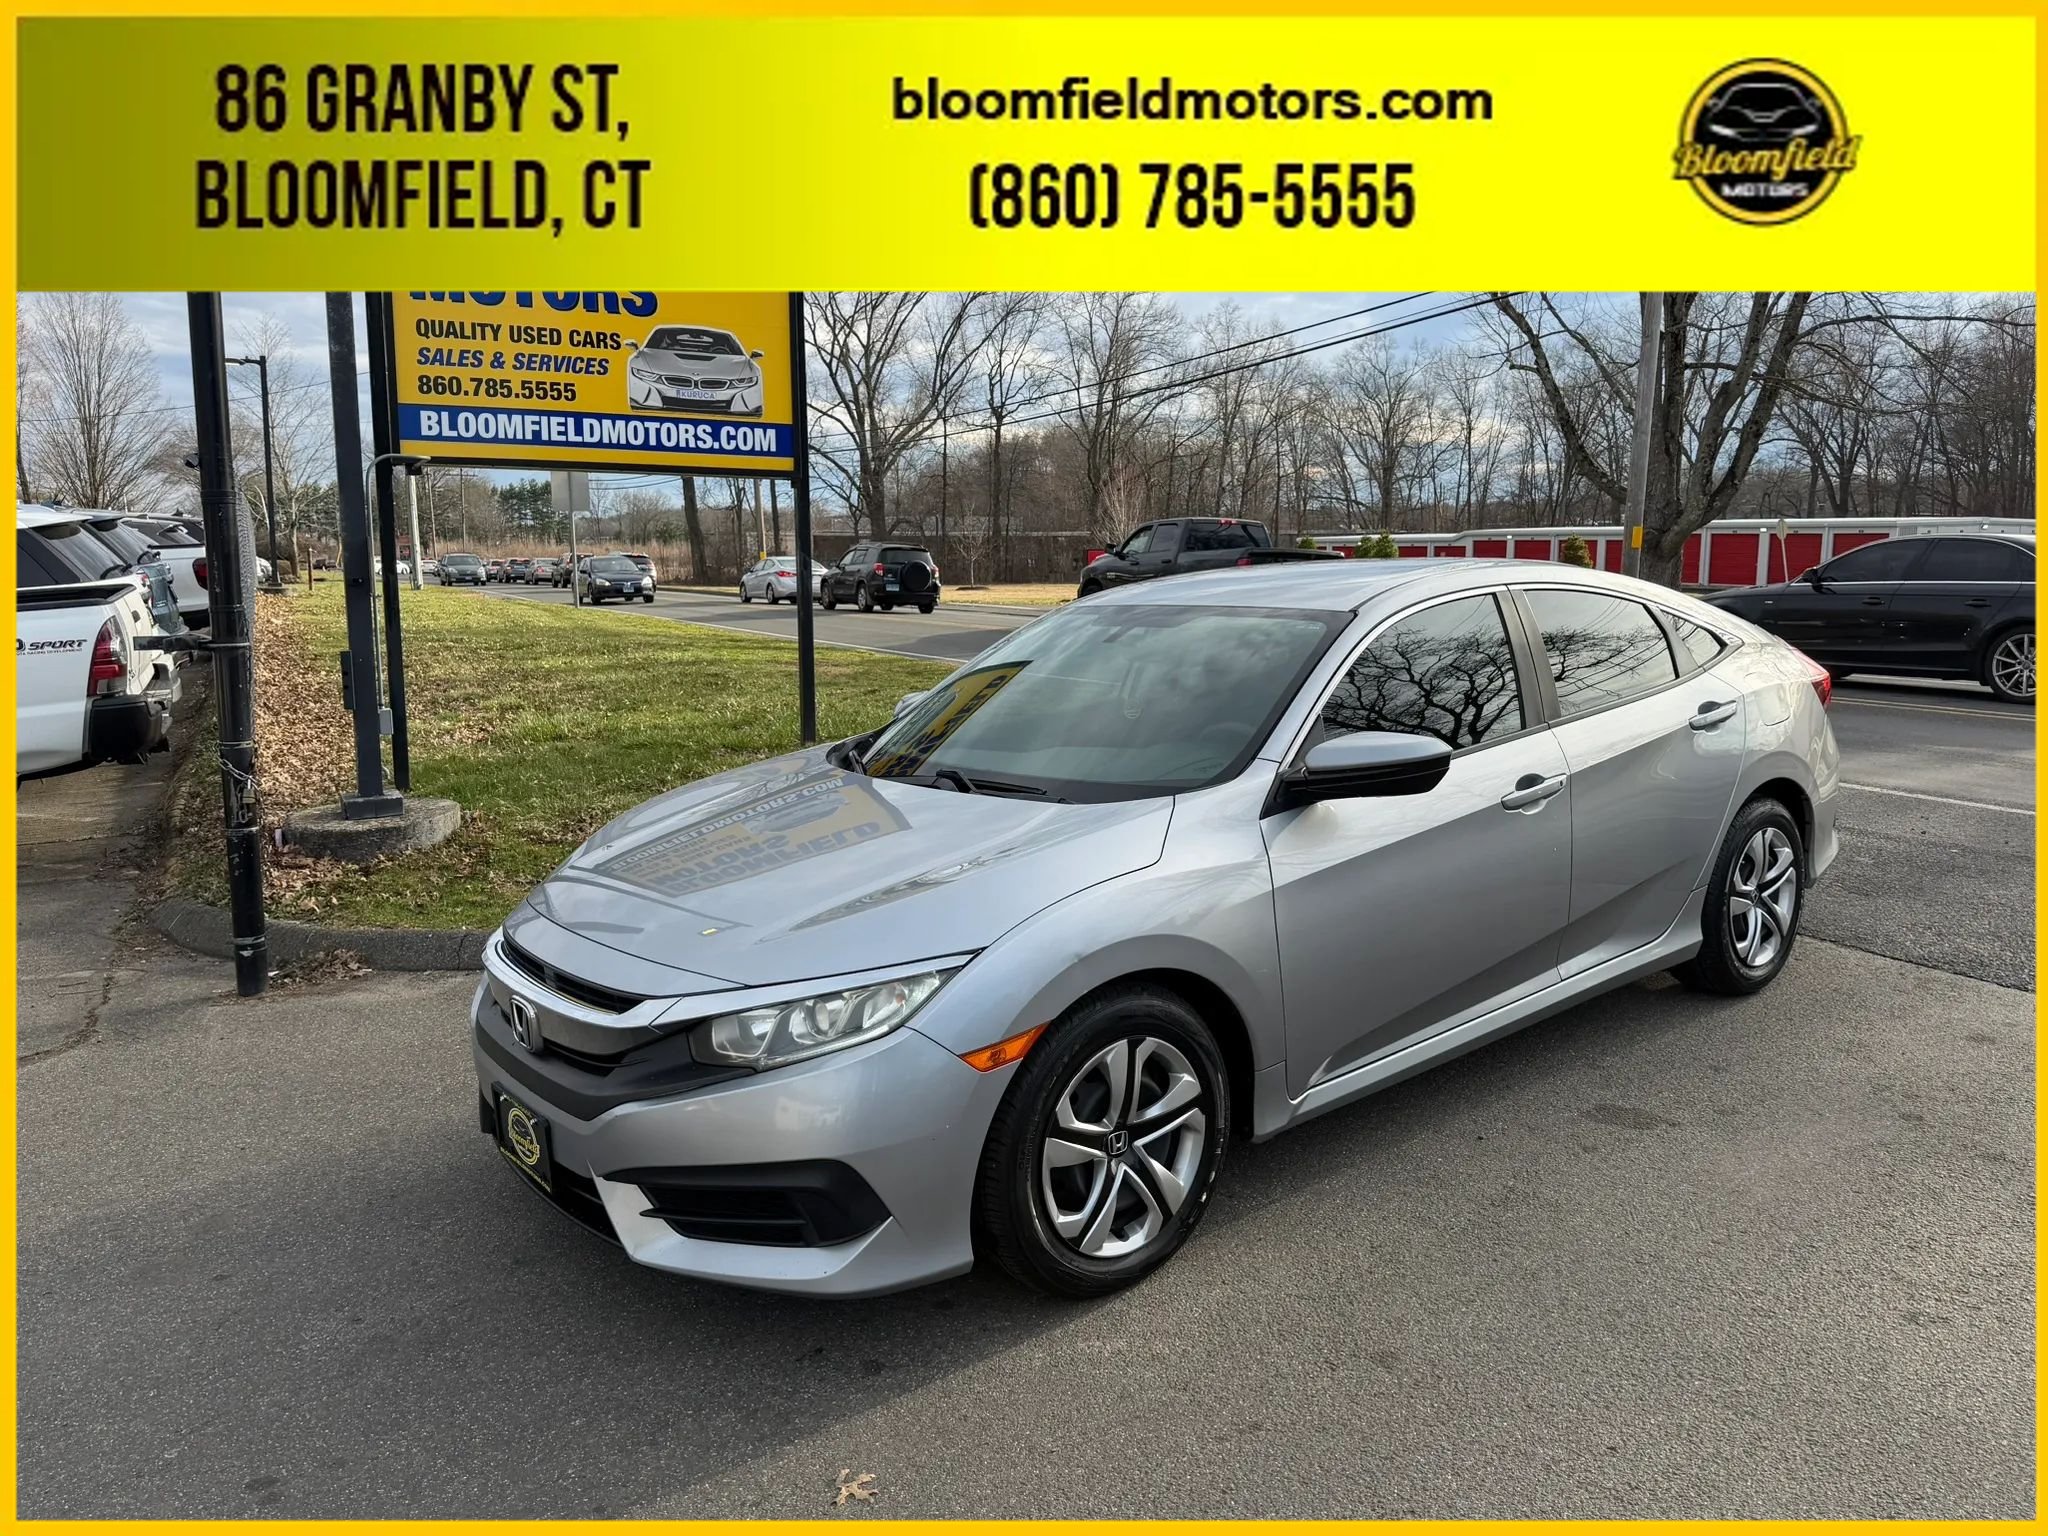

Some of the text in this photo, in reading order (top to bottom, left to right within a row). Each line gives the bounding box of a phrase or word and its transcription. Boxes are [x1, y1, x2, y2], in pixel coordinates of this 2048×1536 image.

[415, 318, 622, 351] QUALITY USED CARS
[416, 346, 610, 376] SALES & SERVICES
[417, 374, 577, 402] 860.785.5555
[419, 410, 777, 453] BLOOMFIELDMOTORS.COM
[28, 639, 88, 651] SPORT
